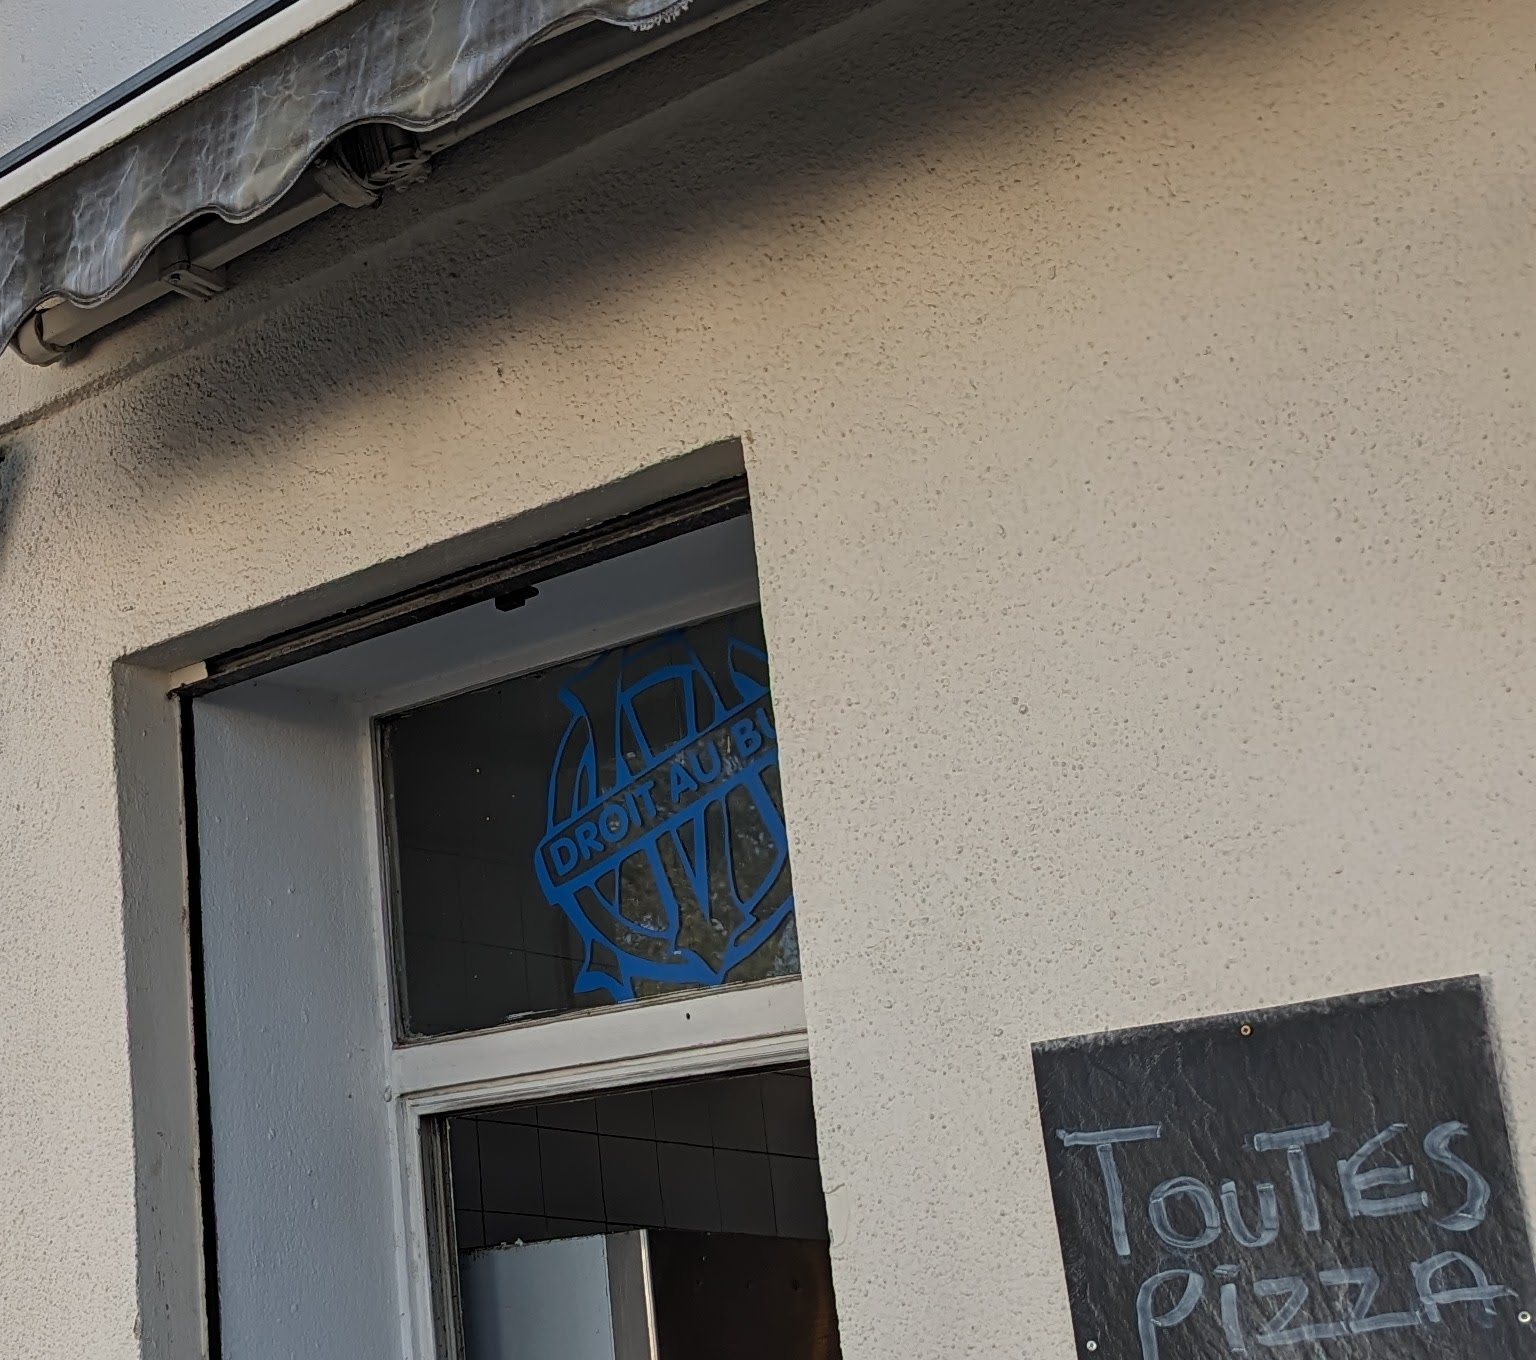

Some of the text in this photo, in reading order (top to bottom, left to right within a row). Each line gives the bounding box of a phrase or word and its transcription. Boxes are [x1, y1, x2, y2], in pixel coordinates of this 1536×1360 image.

[549, 780, 657, 877] DROIT
[669, 741, 722, 804] AU
[1055, 1121, 1492, 1257] TOUTES
